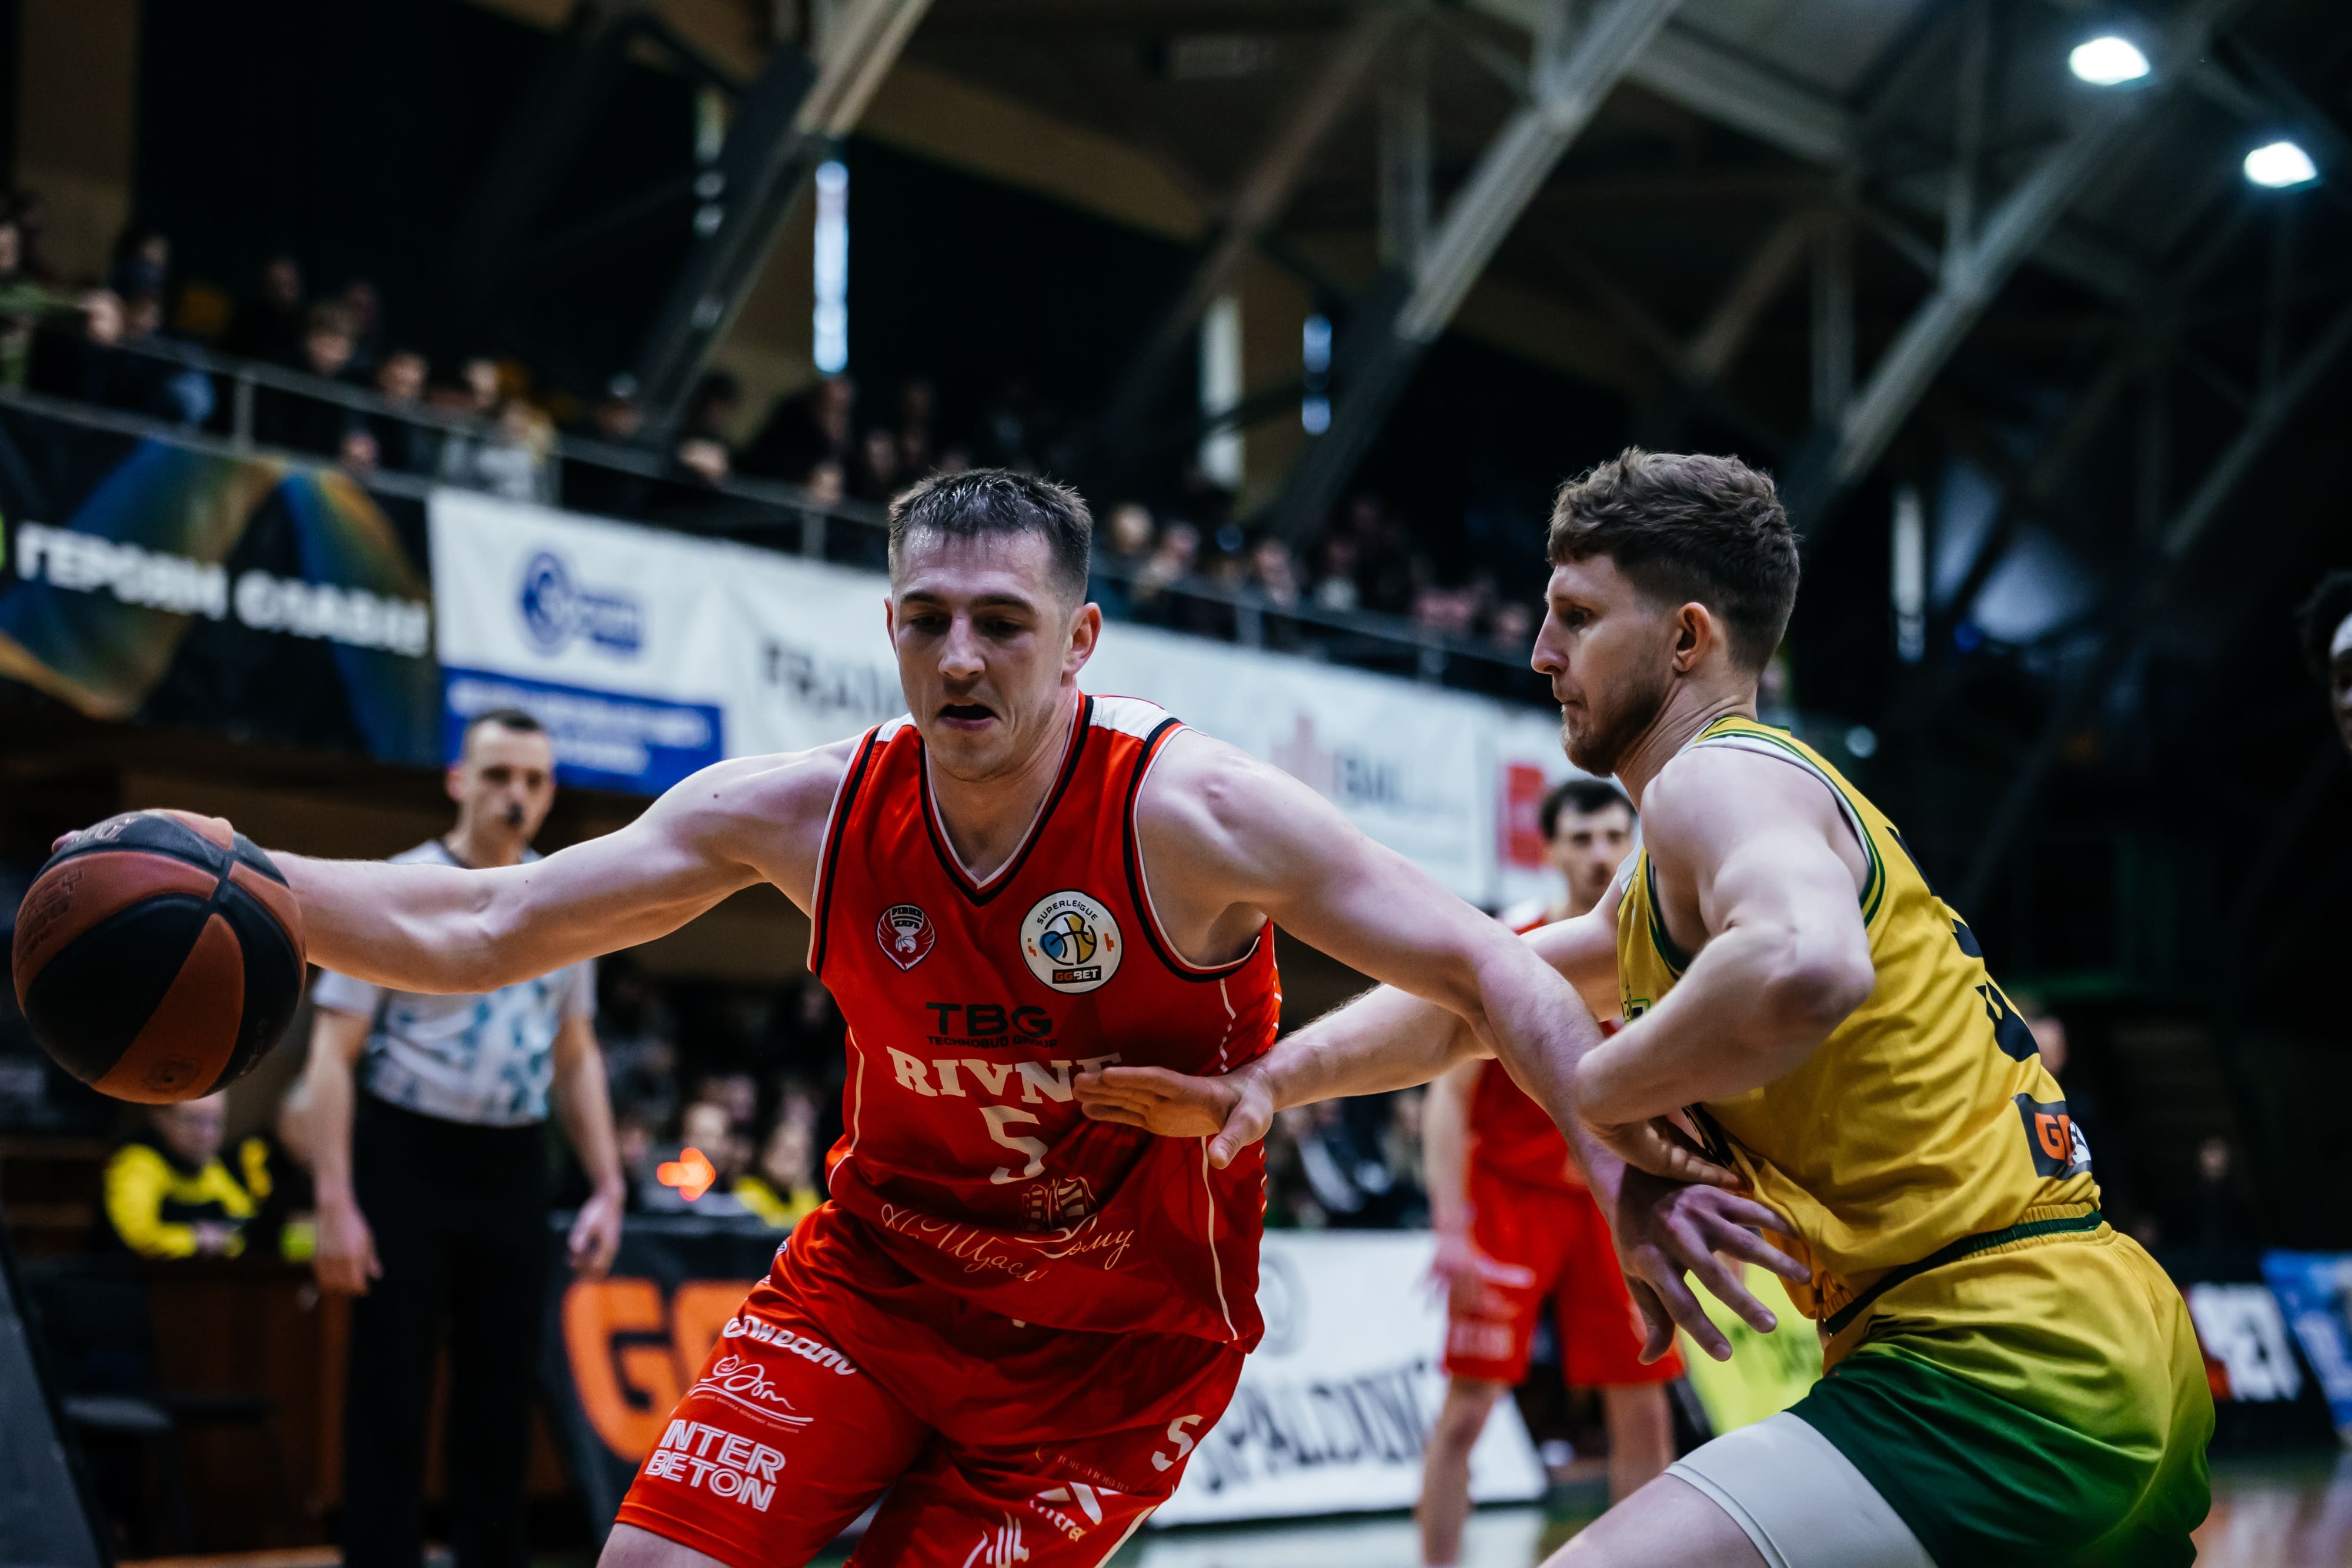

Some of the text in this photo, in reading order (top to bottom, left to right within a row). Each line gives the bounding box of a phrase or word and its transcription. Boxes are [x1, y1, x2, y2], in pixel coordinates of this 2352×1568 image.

[1037, 900, 1098, 925] SUPERLEAGUE
[927, 1002, 1053, 1038] TBG
[927, 1035, 1058, 1049] TECHNOBUD GROUP
[978, 1105, 1048, 1185] 5
[659, 1419, 786, 1483] INTER
[644, 1449, 777, 1513] BETON
